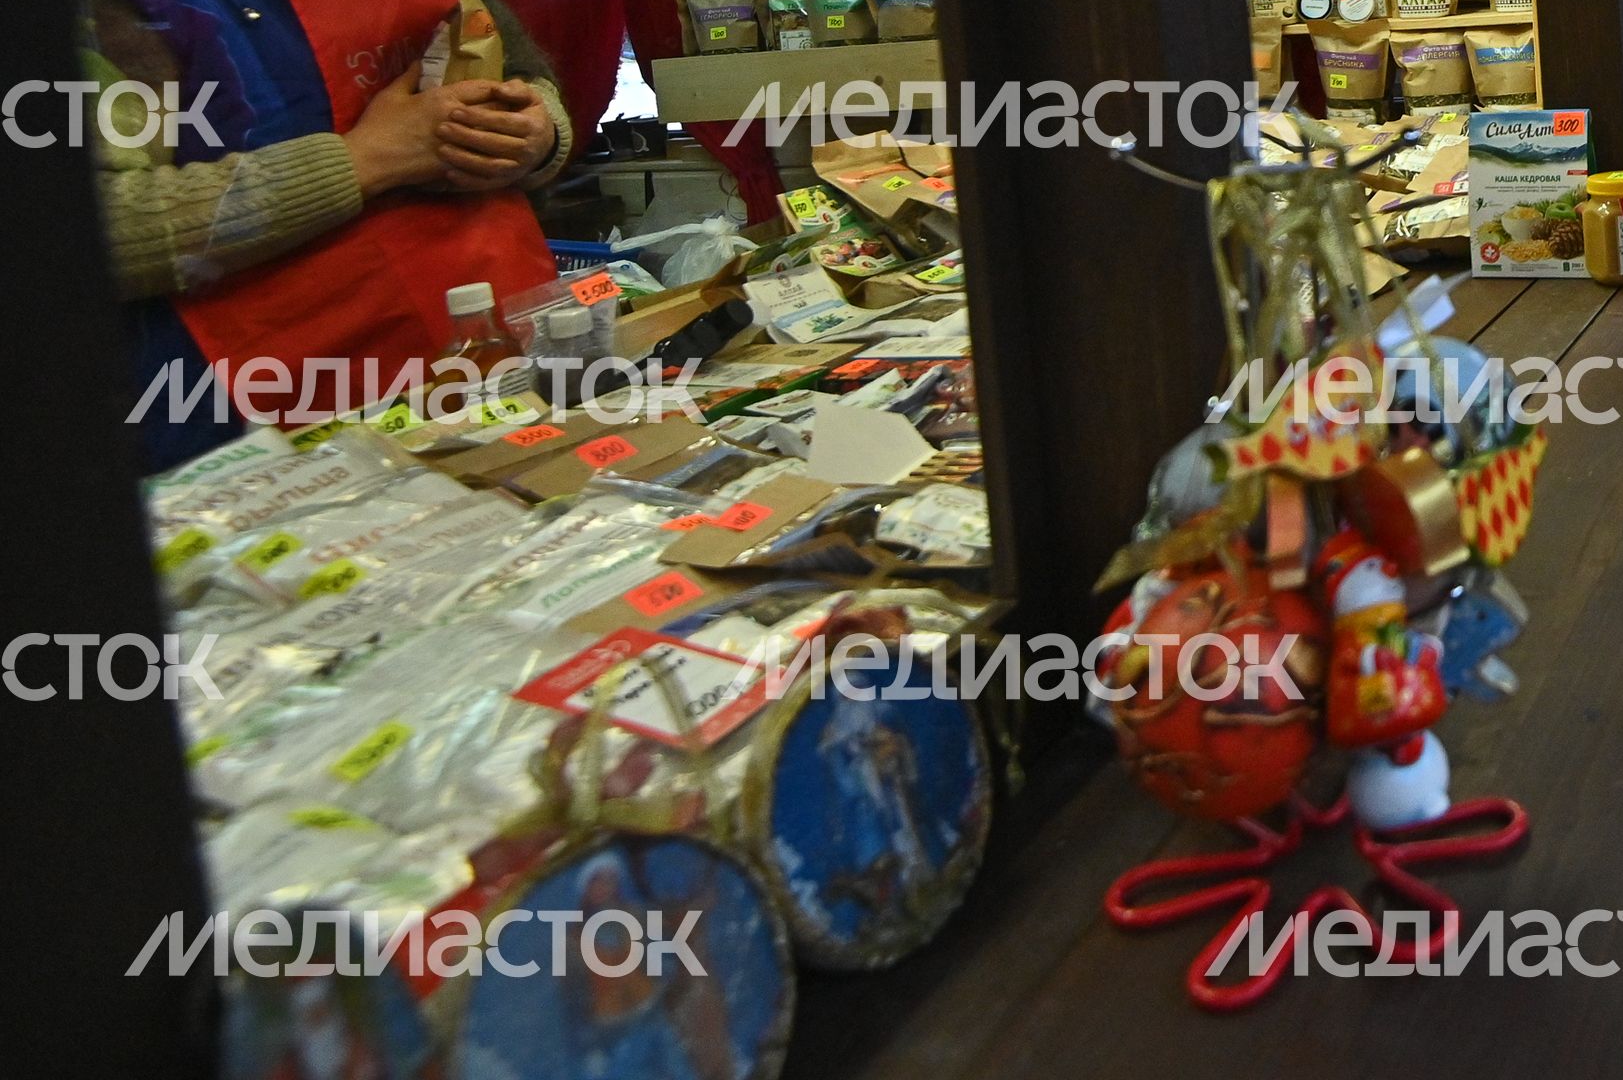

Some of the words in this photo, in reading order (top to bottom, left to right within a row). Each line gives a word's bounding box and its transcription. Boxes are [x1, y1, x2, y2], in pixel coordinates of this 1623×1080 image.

[1485, 121, 1523, 139] Сила
[1518, 122, 1555, 141] Алт
[1555, 118, 1581, 133] 300
[1494, 175, 1518, 183] КАША
[1519, 175, 1562, 184] КЕДРОВАЯ
